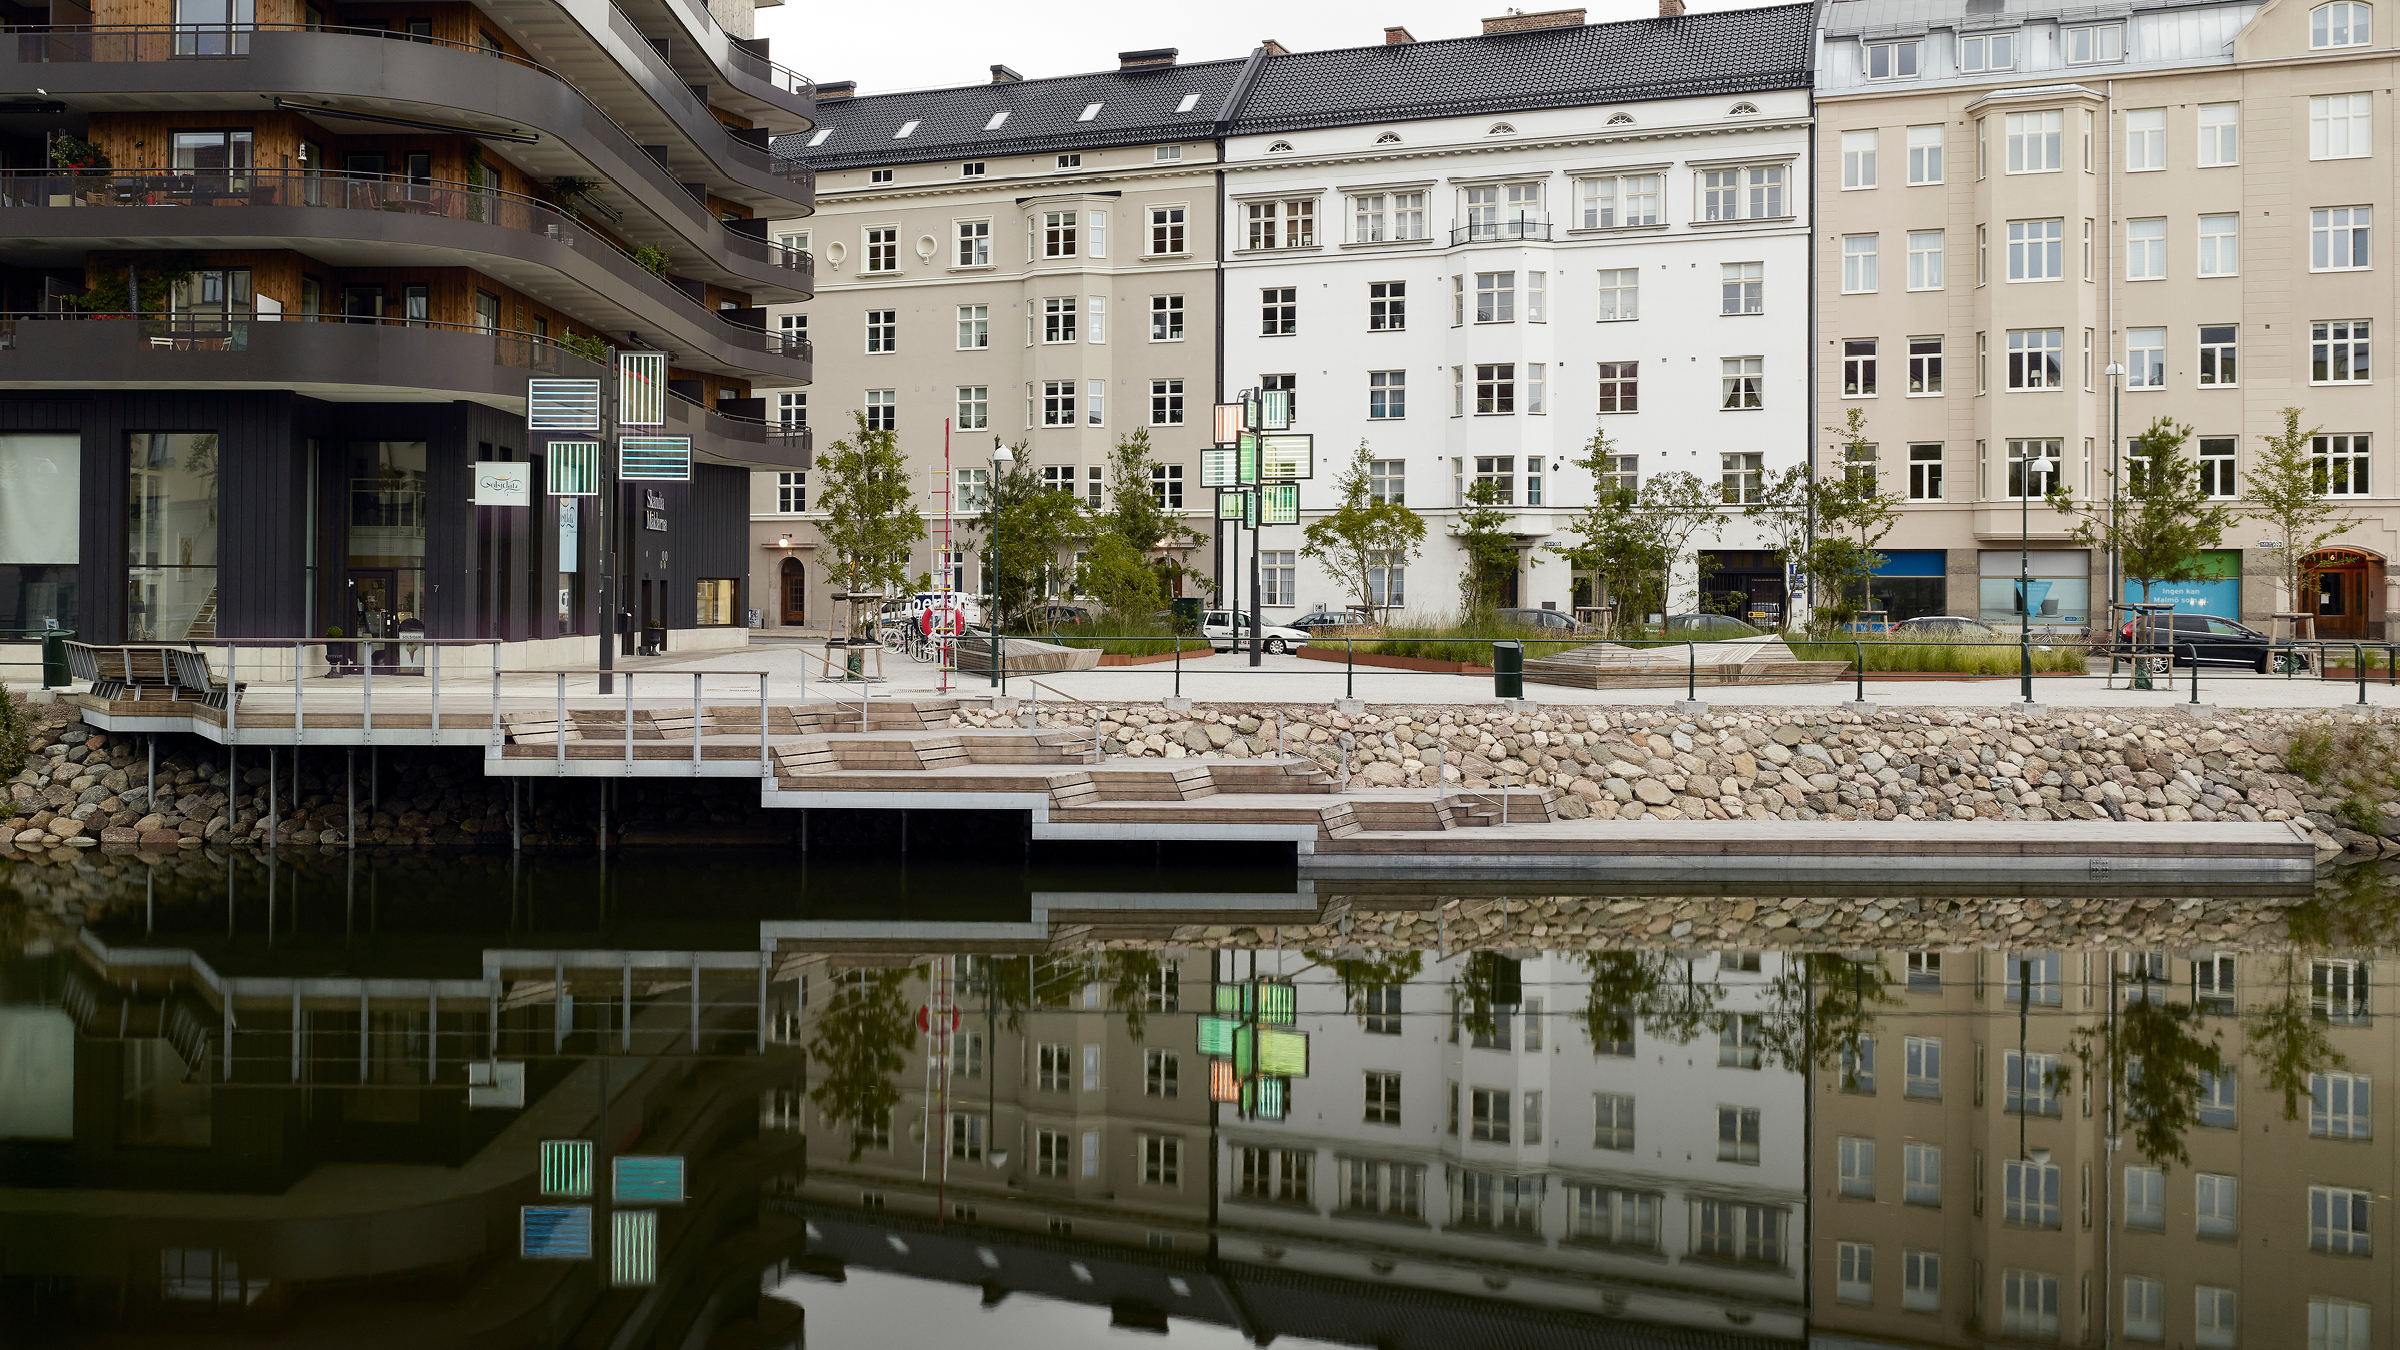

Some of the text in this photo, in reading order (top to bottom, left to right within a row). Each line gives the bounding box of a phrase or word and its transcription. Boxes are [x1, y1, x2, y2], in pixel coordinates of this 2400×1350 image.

[646, 488, 665, 510] Skandia
[646, 510, 668, 532] Mäklarna
[433, 584, 440, 593] 7
[2162, 588, 2184, 596] Ingen
